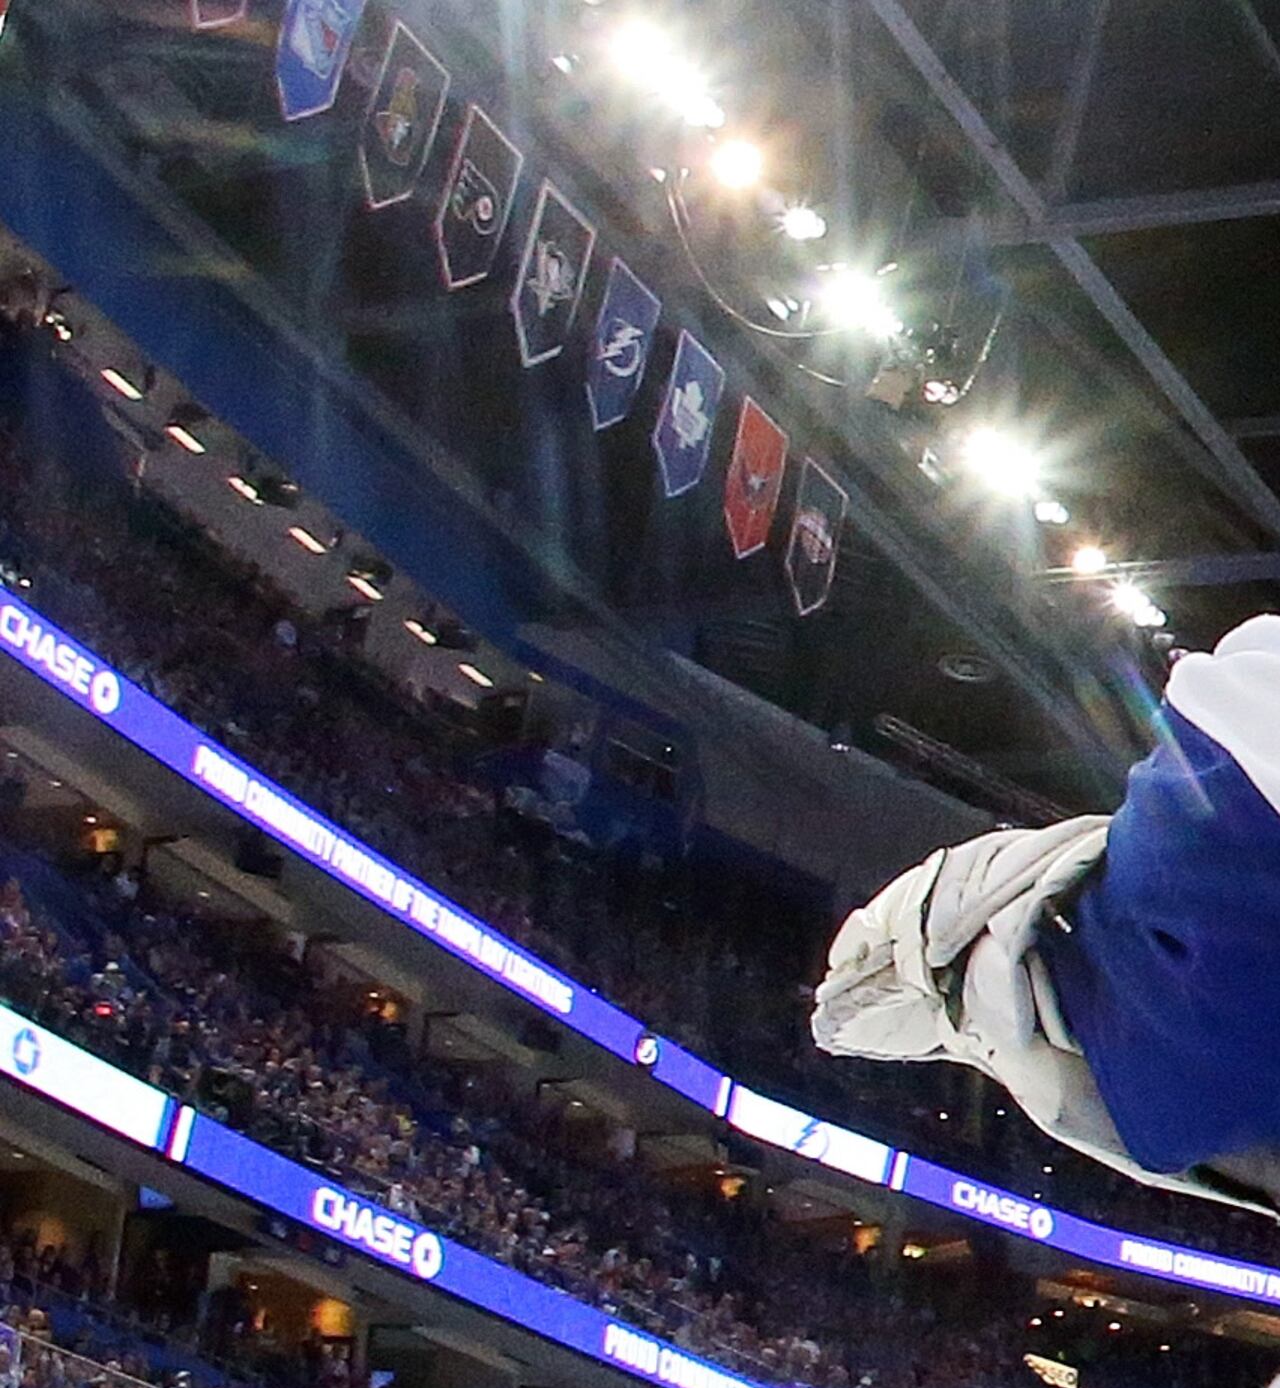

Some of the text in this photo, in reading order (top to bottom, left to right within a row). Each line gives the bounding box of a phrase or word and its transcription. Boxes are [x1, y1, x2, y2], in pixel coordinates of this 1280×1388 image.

[0, 604, 95, 695] CHASE
[313, 1187, 415, 1263] CHASE
[952, 1182, 1030, 1230] CHASE
